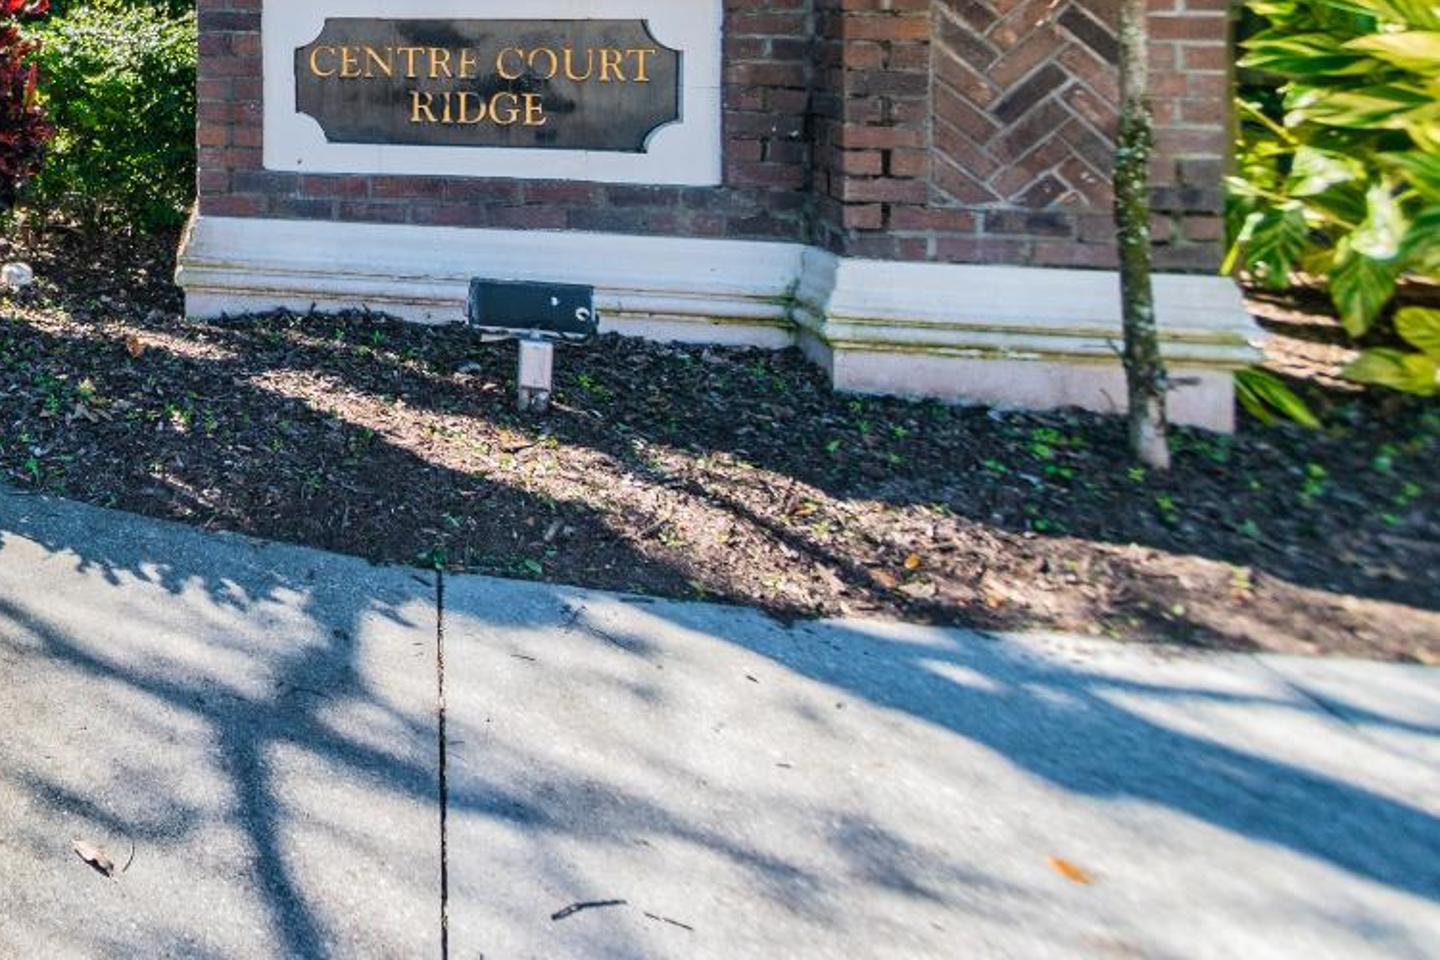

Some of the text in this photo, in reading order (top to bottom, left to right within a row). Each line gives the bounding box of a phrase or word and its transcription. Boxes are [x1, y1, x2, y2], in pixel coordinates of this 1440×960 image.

[309, 45, 656, 82] CENTRE COURT
[410, 90, 547, 126] RIDGE
